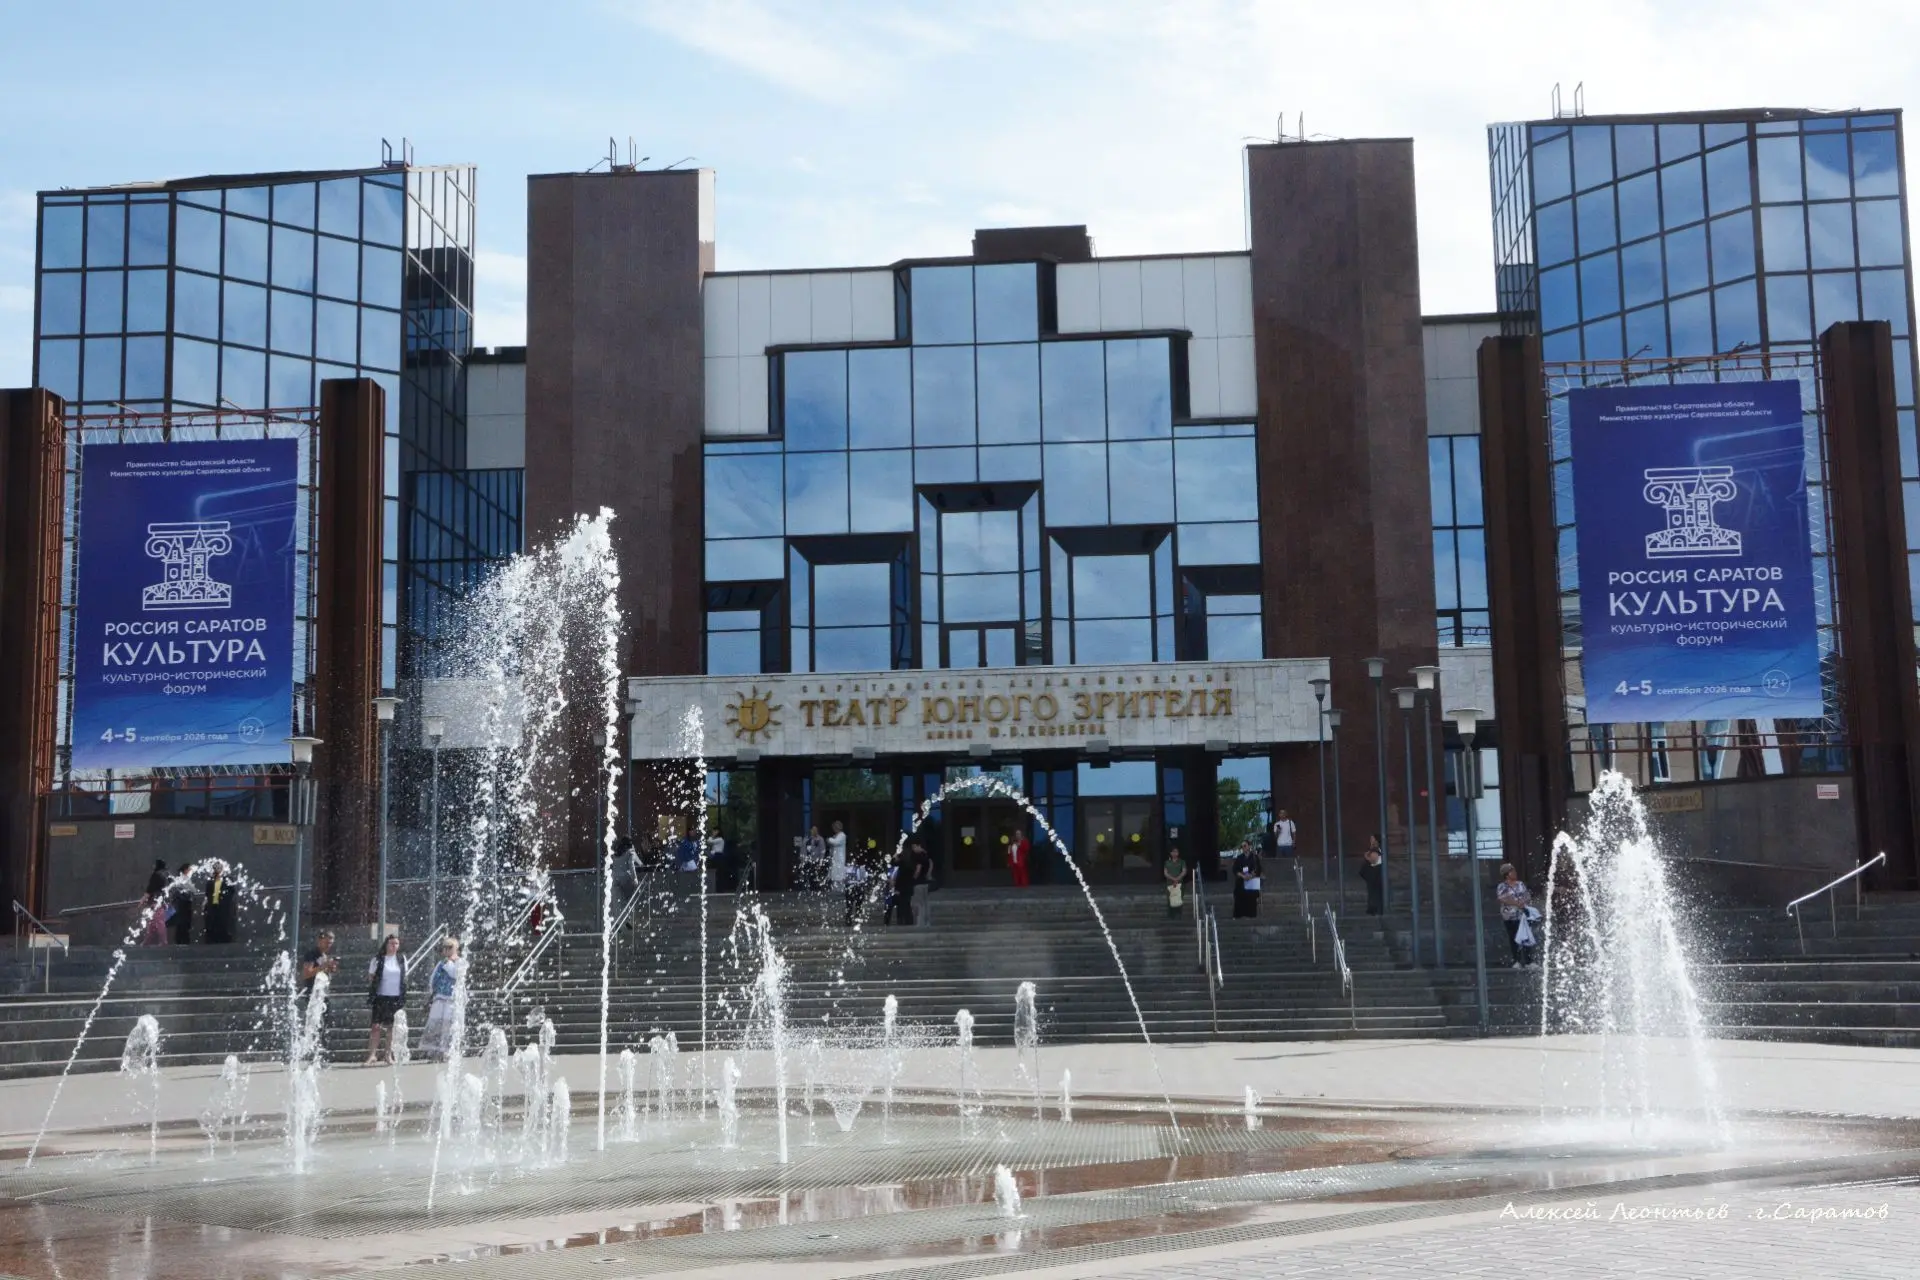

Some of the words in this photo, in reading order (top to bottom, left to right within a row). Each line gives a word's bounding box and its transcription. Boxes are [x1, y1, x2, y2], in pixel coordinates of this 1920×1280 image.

[1673, 402, 1722, 411] Саратовской
[1723, 400, 1755, 409] области
[1599, 414, 1653, 422] Министерство
[1653, 412, 1689, 421] культуры
[1690, 410, 1740, 419] Саратовской
[1740, 408, 1772, 417] области
[180, 458, 226, 468] Саратовской
[227, 457, 256, 466] области
[110, 470, 161, 478] Министерство
[162, 468, 195, 478] культуры
[195, 466, 241, 476] Саратовской
[242, 465, 271, 474] области
[1608, 569, 1688, 586] РОССИЯ
[1693, 566, 1783, 583] САРАТОВ
[1608, 587, 1786, 617] КУЛЬТУРА
[104, 621, 179, 636] РОССИЯ
[184, 618, 268, 634] САРАТОВ
[1610, 617, 1788, 635] культурно-исторический
[1676, 633, 1724, 647] форум
[102, 638, 267, 667] КУЛЬТУРА
[102, 667, 267, 684] культурно-исторический
[162, 683, 207, 696] форум
[1614, 679, 1653, 696] 4-5
[1656, 685, 1701, 696] сентября
[1729, 686, 1752, 695] года
[1765, 678, 1788, 690] 12+
[800, 697, 908, 727] ТЕАТР
[921, 693, 1059, 724] ЮНОГО
[1073, 688, 1233, 721] ЗРИТЕЛЯ
[100, 727, 137, 743] 4-5
[140, 732, 182, 743] сентября
[183, 732, 206, 742] 2026
[207, 733, 229, 742] года
[241, 725, 262, 736] 12+
